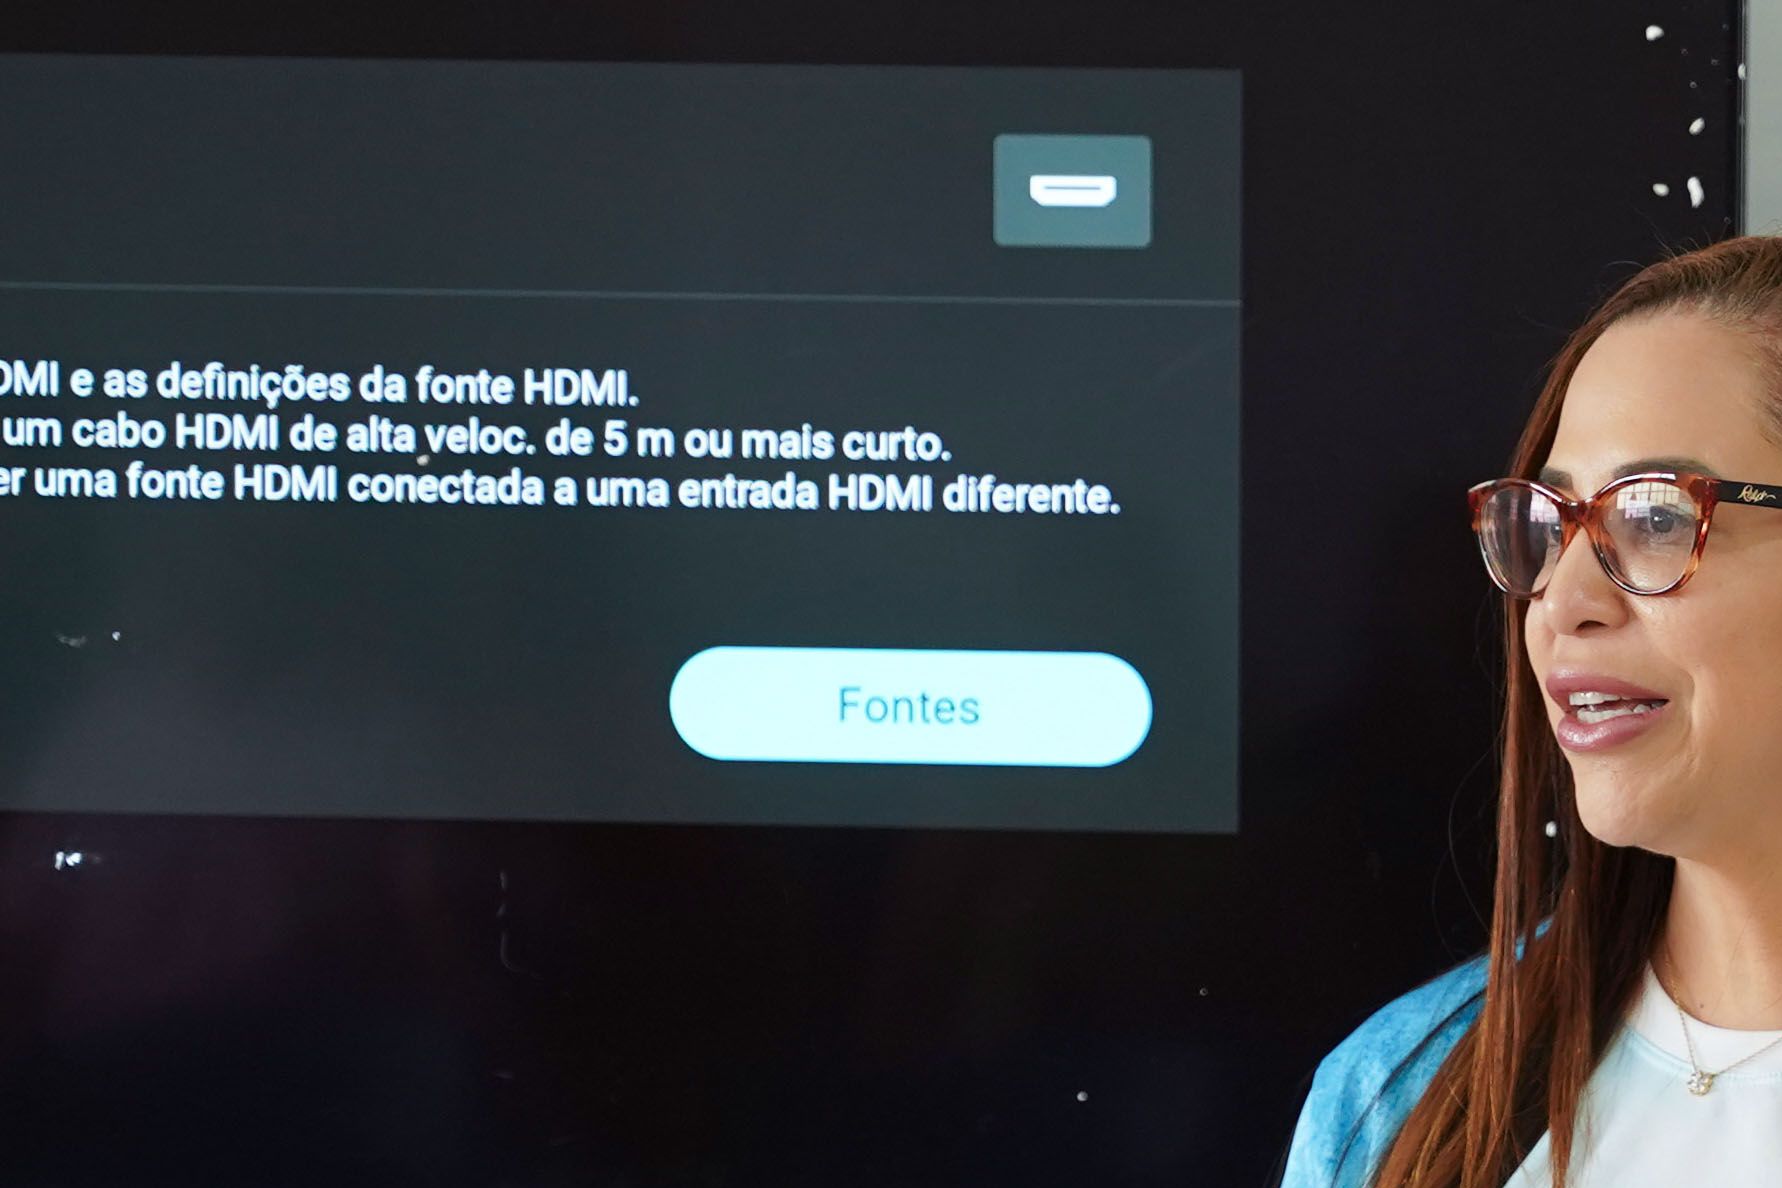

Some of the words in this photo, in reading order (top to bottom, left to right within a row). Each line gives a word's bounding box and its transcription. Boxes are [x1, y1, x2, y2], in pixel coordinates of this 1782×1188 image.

[70, 368, 94, 397] e
[103, 369, 148, 398] as
[156, 361, 351, 409] definições
[359, 365, 406, 402] da
[415, 365, 514, 404] fonte
[524, 368, 639, 406] HDMI.
[3, 417, 62, 447] um
[72, 410, 166, 448] cabo
[176, 413, 279, 450] HDMI
[289, 414, 337, 451] de
[347, 415, 416, 454] alta
[425, 418, 536, 455] veloc.
[545, 418, 594, 455] de
[604, 420, 628, 456] 5
[637, 428, 674, 457] m
[684, 429, 732, 458] ou
[742, 423, 835, 459] mais
[842, 426, 952, 461] curto.
[35, 468, 116, 497] uma
[125, 460, 224, 499] fonte
[235, 464, 338, 502] HDMI
[348, 467, 544, 505] conectada
[554, 477, 577, 506] a
[587, 477, 669, 507] uma
[678, 472, 819, 509] entrada
[829, 474, 932, 511] HDMI
[943, 476, 1120, 514] diferente.
[838, 685, 981, 725] Fontes
